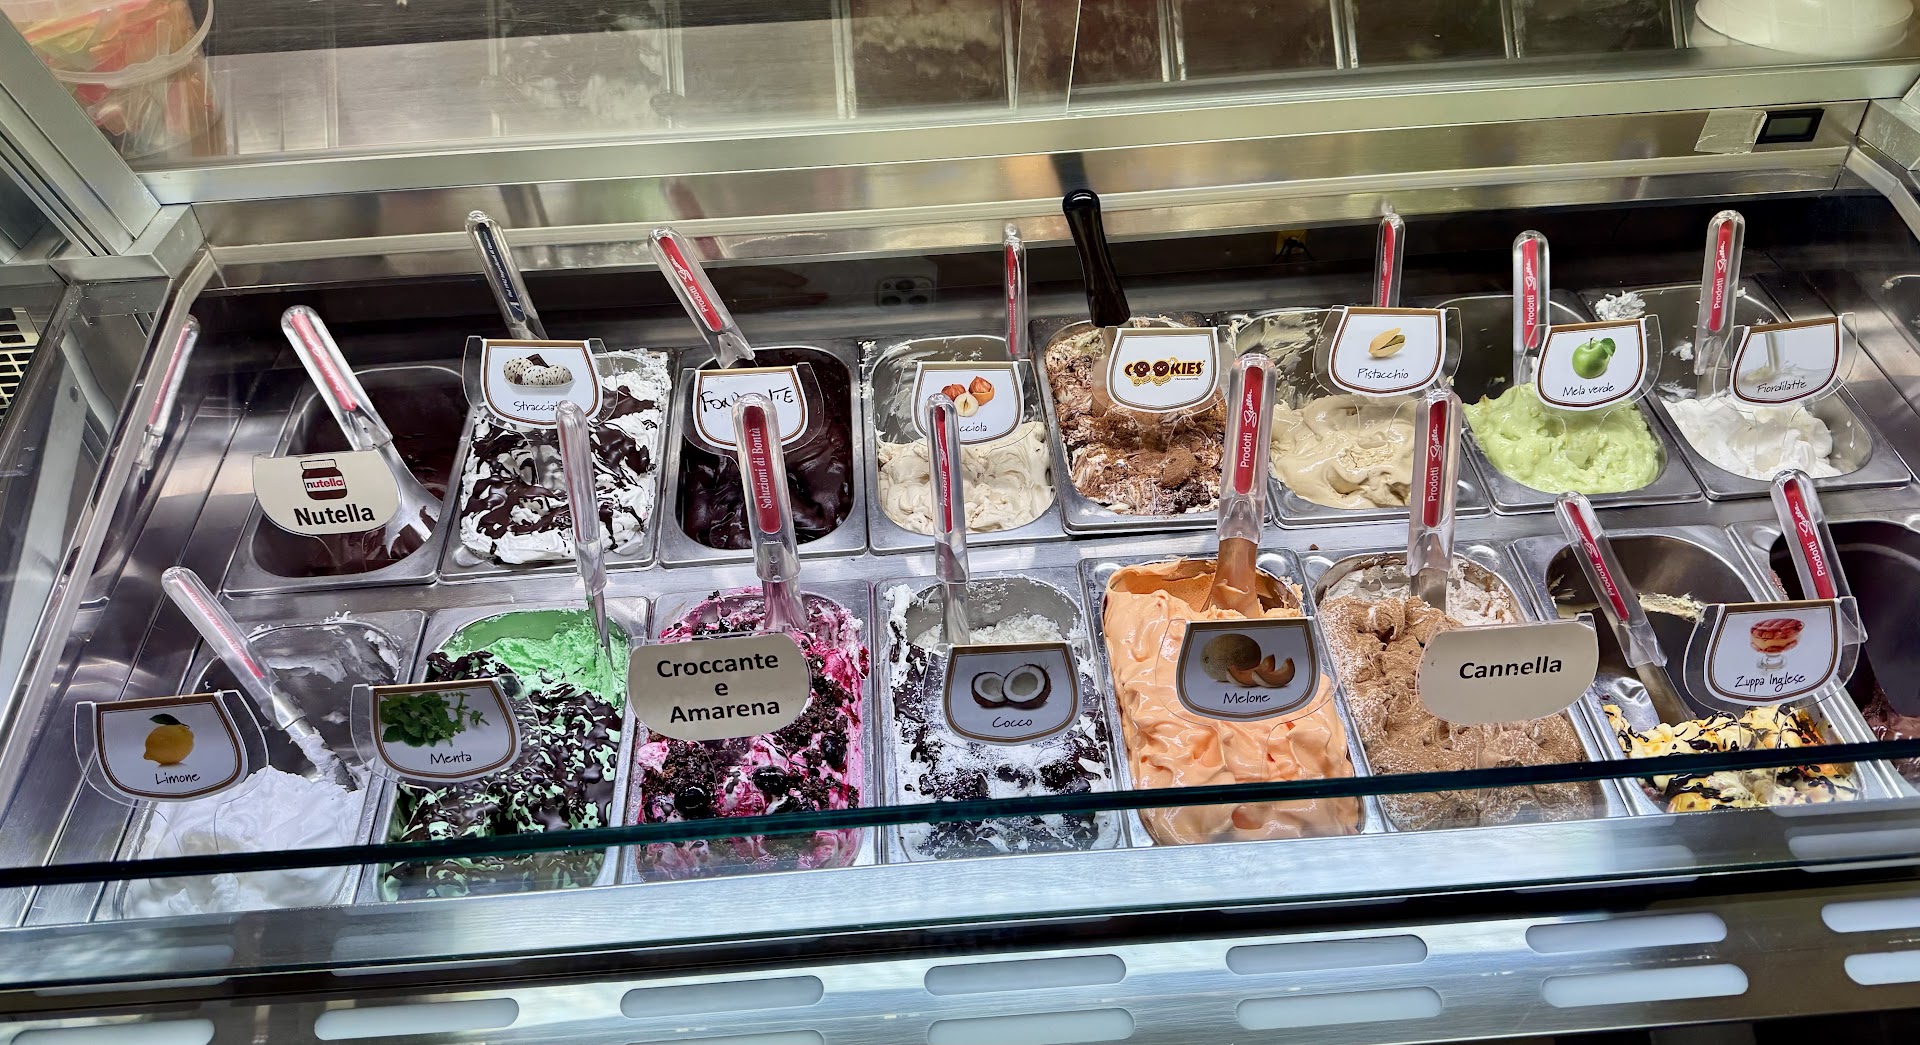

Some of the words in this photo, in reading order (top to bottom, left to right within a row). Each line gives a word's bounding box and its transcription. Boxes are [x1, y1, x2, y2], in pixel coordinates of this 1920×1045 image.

[688, 285, 708, 313] Prodotti
[1714, 277, 1724, 309] Prodotti
[1527, 295, 1535, 325] Prodotti
[1124, 360, 1203, 377] COOKIES
[1357, 367, 1409, 379] Pistacchio
[1562, 385, 1586, 397] Mela
[1588, 381, 1615, 394] verde
[1756, 379, 1807, 393] Fiordilatte
[749, 427, 765, 454] Bontà
[1241, 432, 1253, 468] Prodotti
[753, 455, 766, 468] di
[306, 478, 344, 489] nutella
[755, 469, 773, 510] Soluzioni
[1428, 466, 1439, 502] Prodotti
[293, 503, 376, 526] Nutella
[1807, 541, 1826, 577] Prodotti
[656, 653, 779, 678] Croccante
[1459, 656, 1562, 679] Cannella
[714, 682, 729, 696] e
[1734, 675, 1765, 692] Zuppa
[1769, 671, 1806, 692] Inglese
[1222, 690, 1271, 704] Melone
[670, 701, 780, 724] Amarena
[992, 716, 1033, 728] Cocco
[430, 750, 472, 765] Menta
[155, 771, 201, 785] Limone
